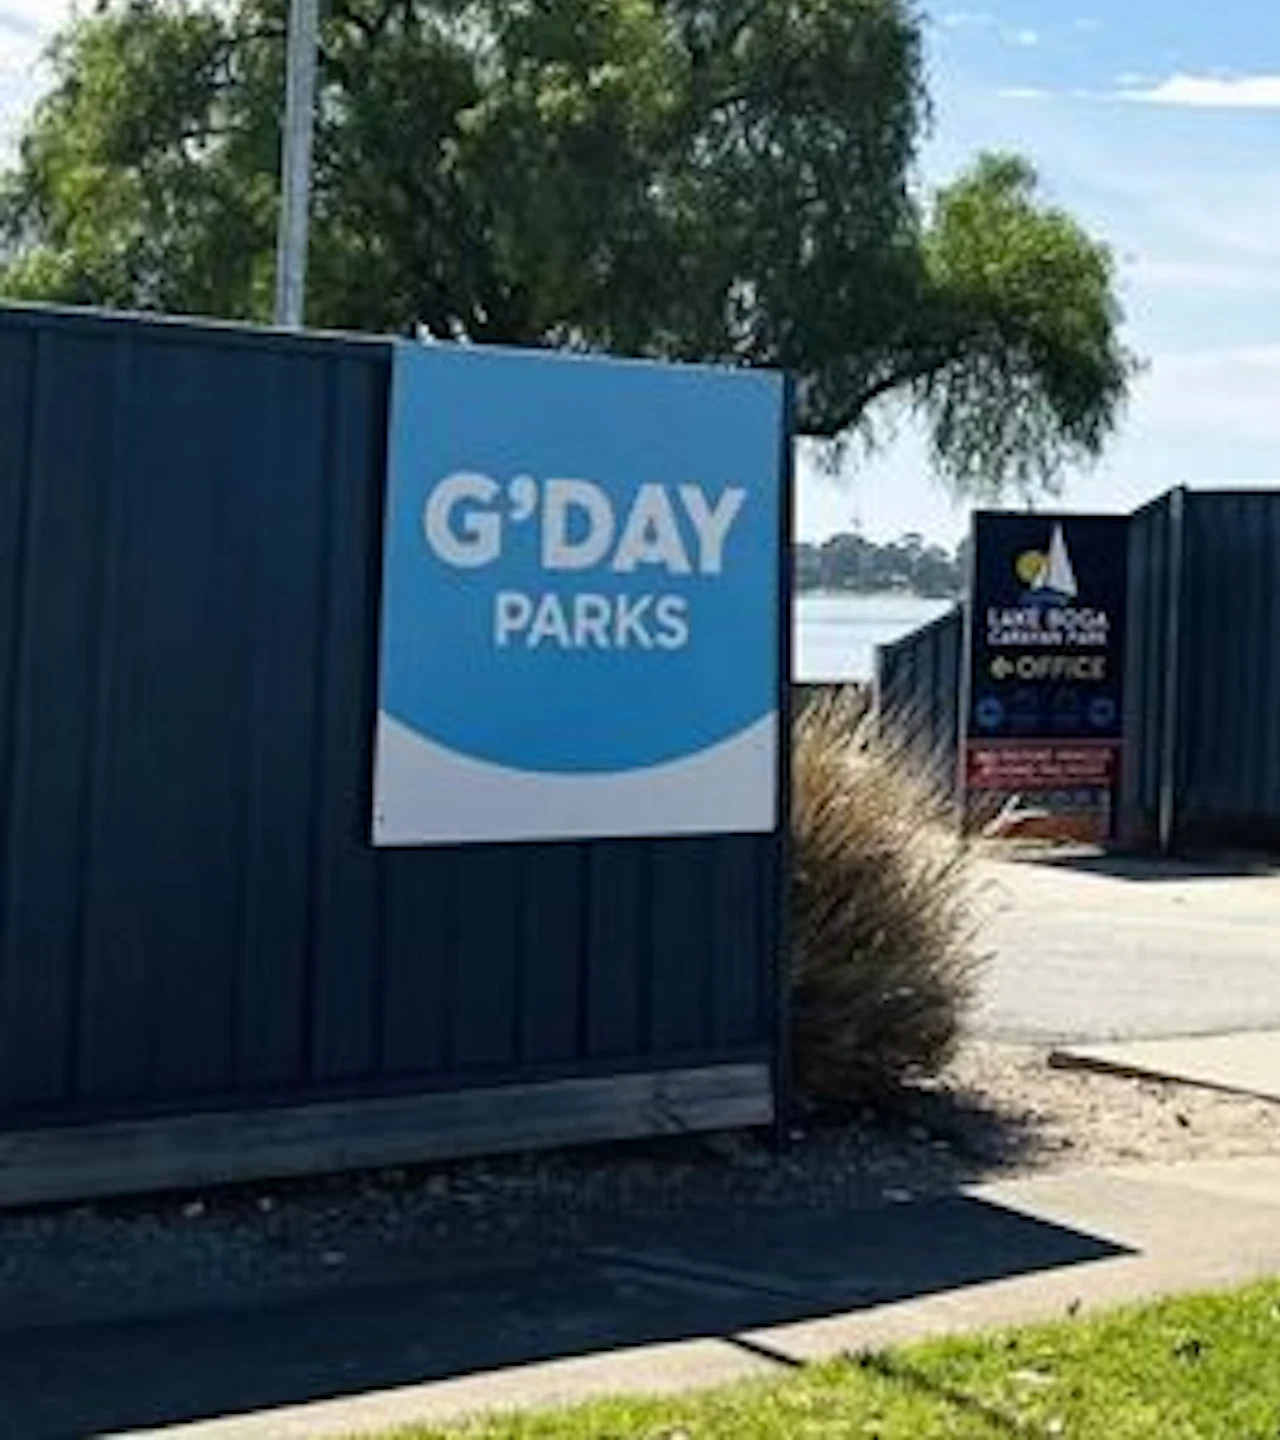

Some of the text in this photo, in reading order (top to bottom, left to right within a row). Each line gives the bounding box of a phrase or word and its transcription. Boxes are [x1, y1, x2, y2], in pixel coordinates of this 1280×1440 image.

[423, 470, 747, 576] G'DAY
[494, 591, 690, 649] PARKS
[986, 607, 1110, 631] LAKE BOGA
[986, 631, 1063, 647] CARAVAN
[1016, 654, 1107, 680] OFFICE
